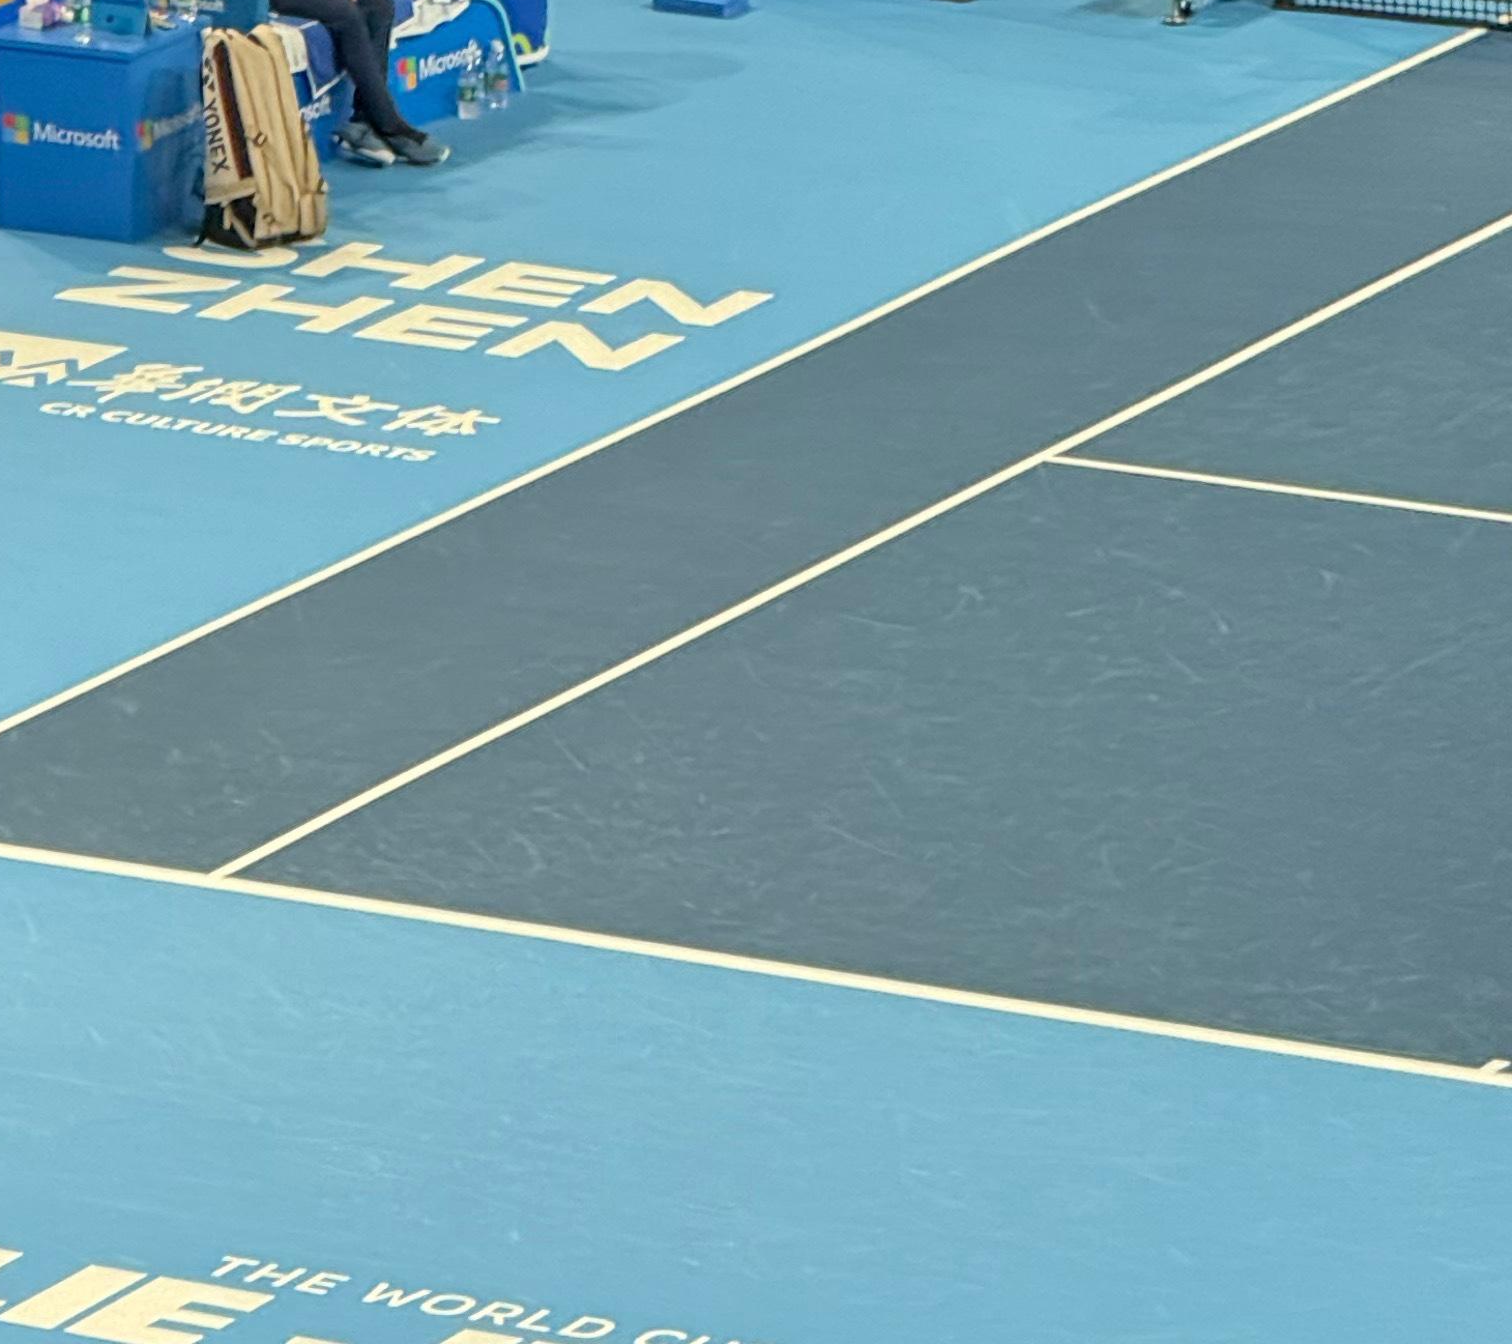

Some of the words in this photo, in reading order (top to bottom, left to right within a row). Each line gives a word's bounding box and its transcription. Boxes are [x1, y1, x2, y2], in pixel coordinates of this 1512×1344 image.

[32, 122, 120, 151] Microsoft
[202, 97, 230, 175] YONEX
[53, 266, 686, 372] ZHEN
[162, 241, 775, 327] SHEN
[39, 400, 96, 420] CR
[100, 410, 278, 443] CULTURE
[275, 433, 438, 462] SPORTS
[211, 1255, 350, 1296] THE
[361, 1280, 616, 1340] WORLD
